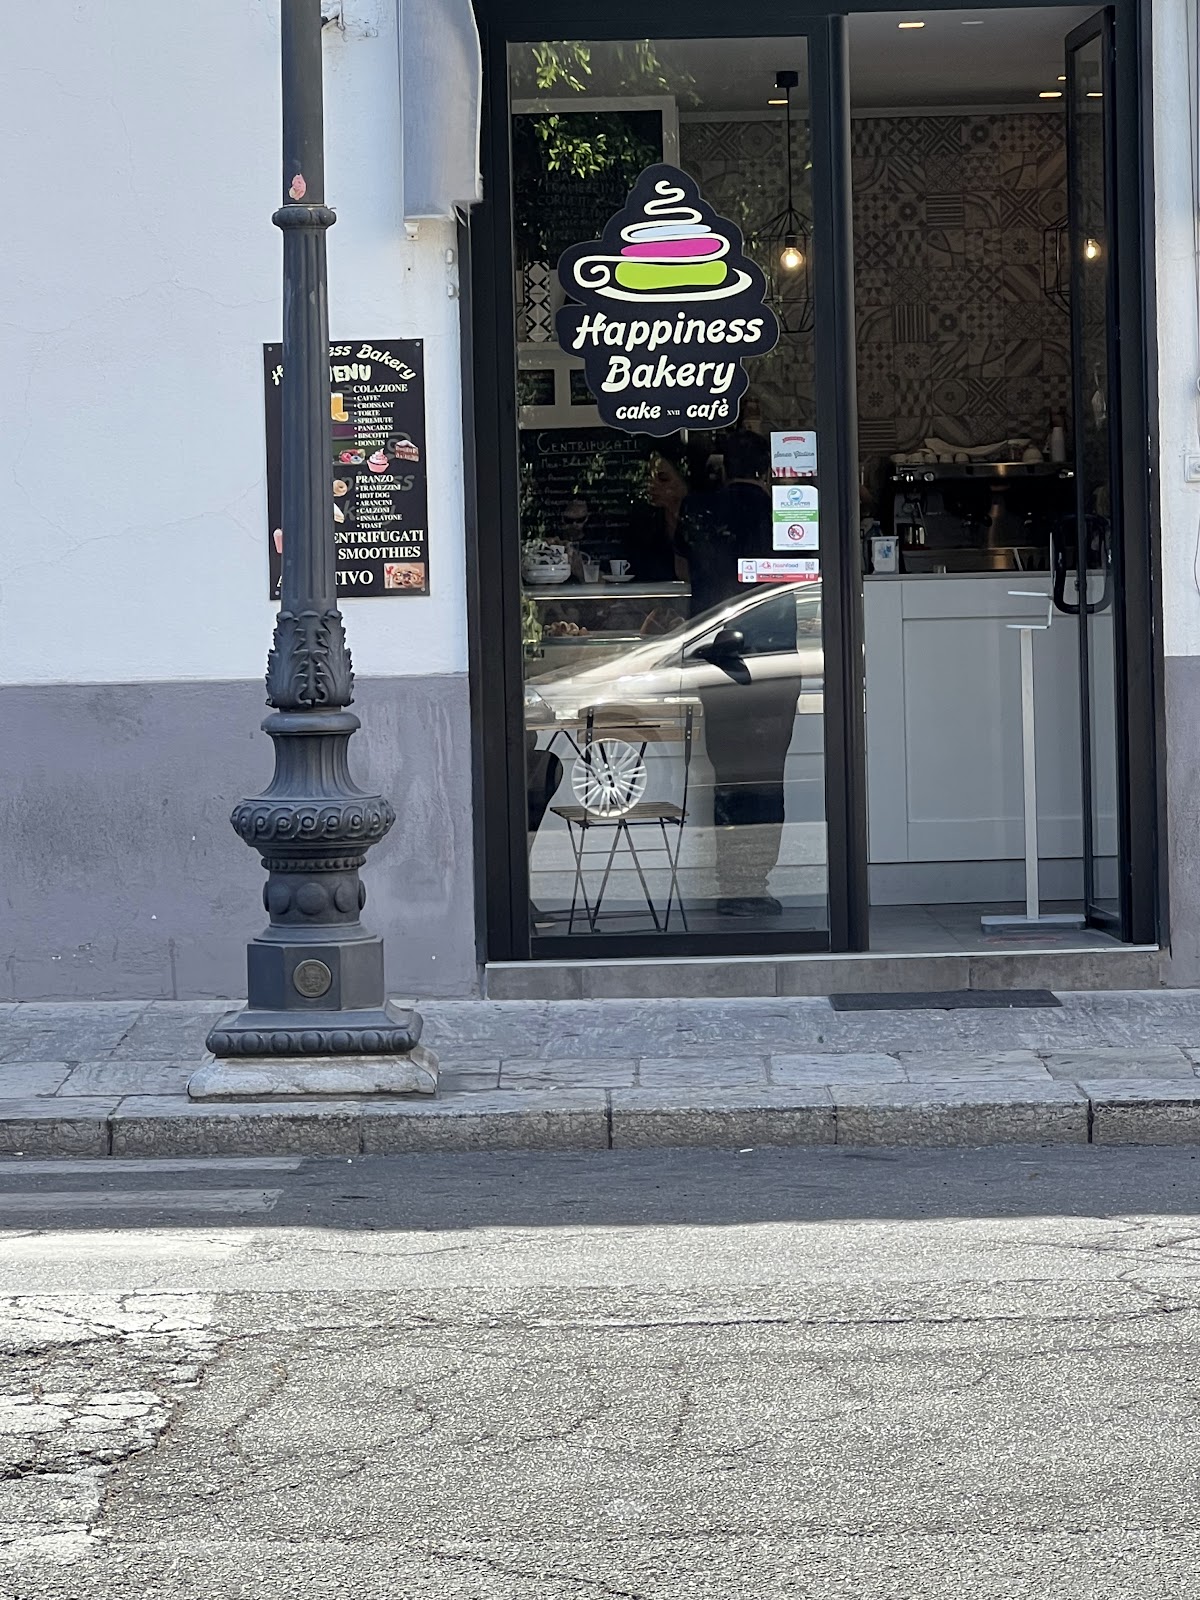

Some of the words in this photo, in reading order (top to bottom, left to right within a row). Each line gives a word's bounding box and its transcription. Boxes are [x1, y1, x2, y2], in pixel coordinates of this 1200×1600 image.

[572, 311, 764, 352] Happiness
[356, 343, 416, 381] Bakery
[329, 363, 371, 383] ENU
[601, 354, 736, 394] Bakery
[353, 383, 408, 393] COLAZIONE
[615, 401, 661, 420] cake
[686, 397, 730, 420] cafè
[356, 474, 394, 484] PRANZO
[360, 514, 402, 522] INSALATONE
[333, 528, 424, 543] ENTRIFUGATI
[338, 546, 421, 560] SMOOTHIES
